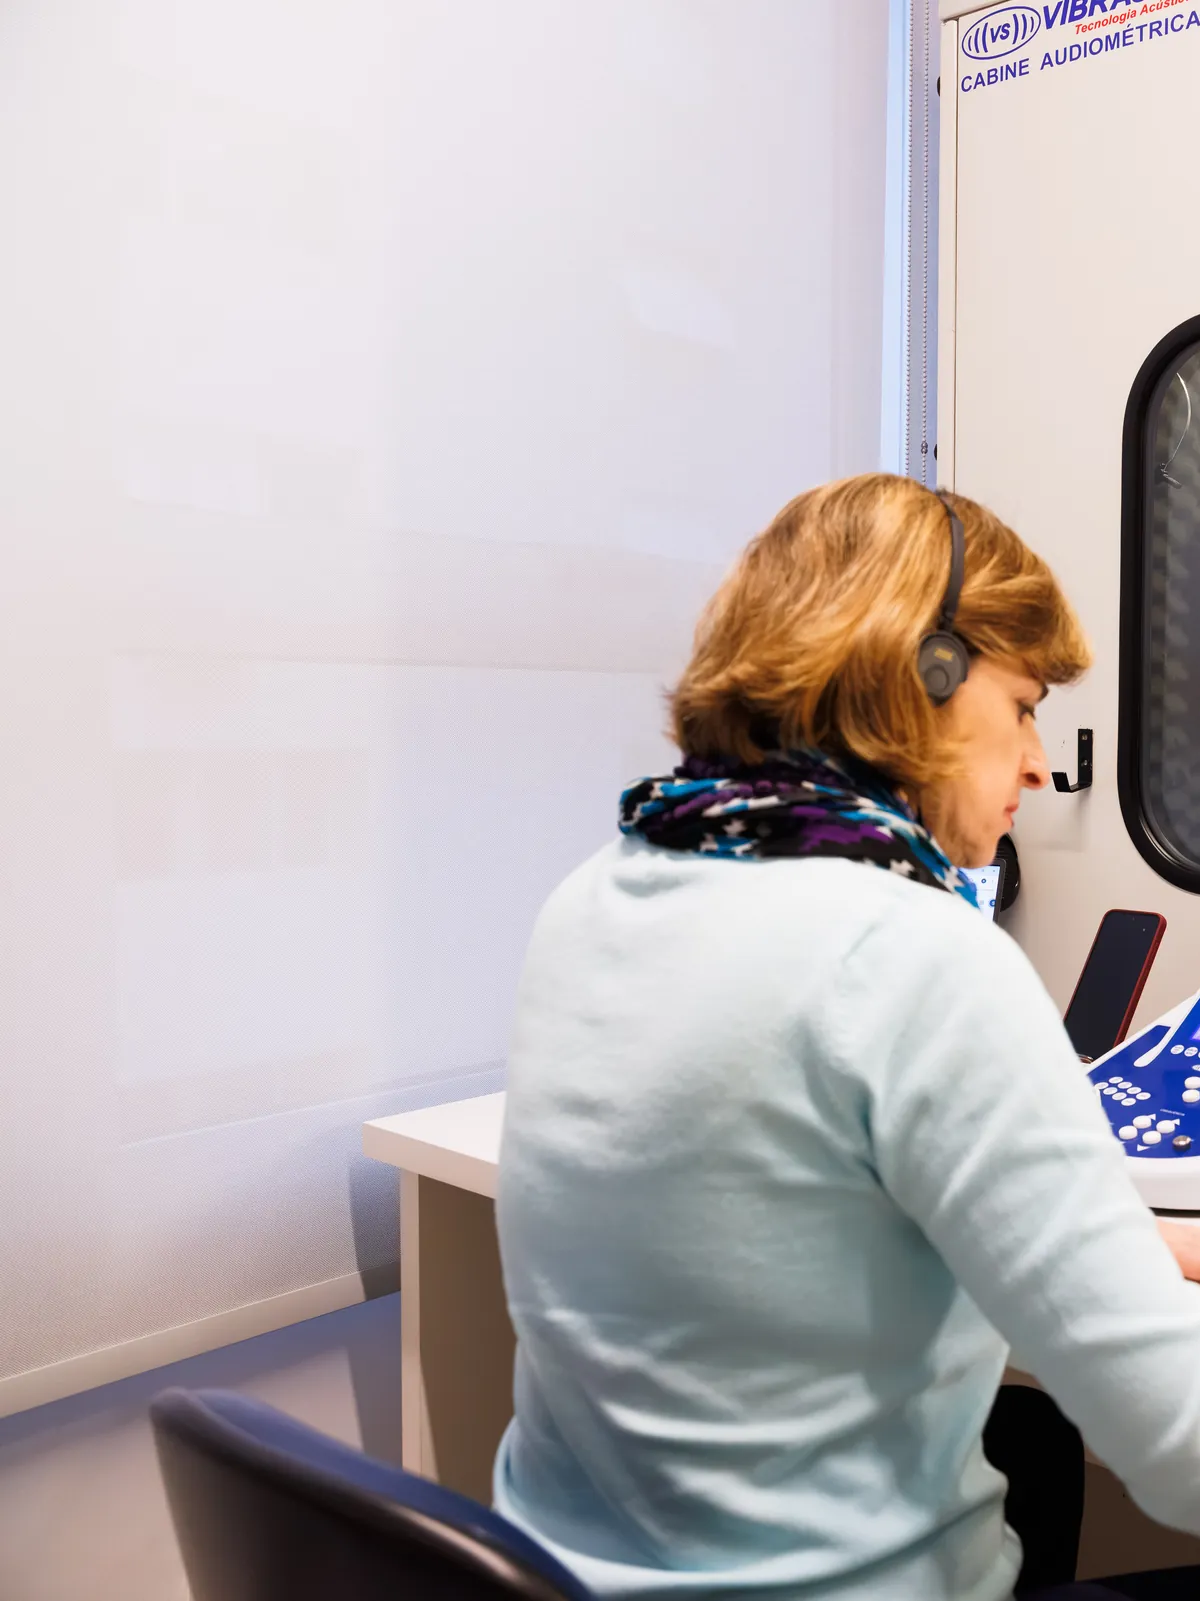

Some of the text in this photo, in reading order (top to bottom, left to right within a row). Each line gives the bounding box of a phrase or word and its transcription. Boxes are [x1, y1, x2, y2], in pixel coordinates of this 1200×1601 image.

[1043, 0, 1143, 30] VIBR
[1075, 0, 1188, 35] Tecnologia Acúst
[961, 10, 1200, 92] CABINE AUDIOMÉTRICA
